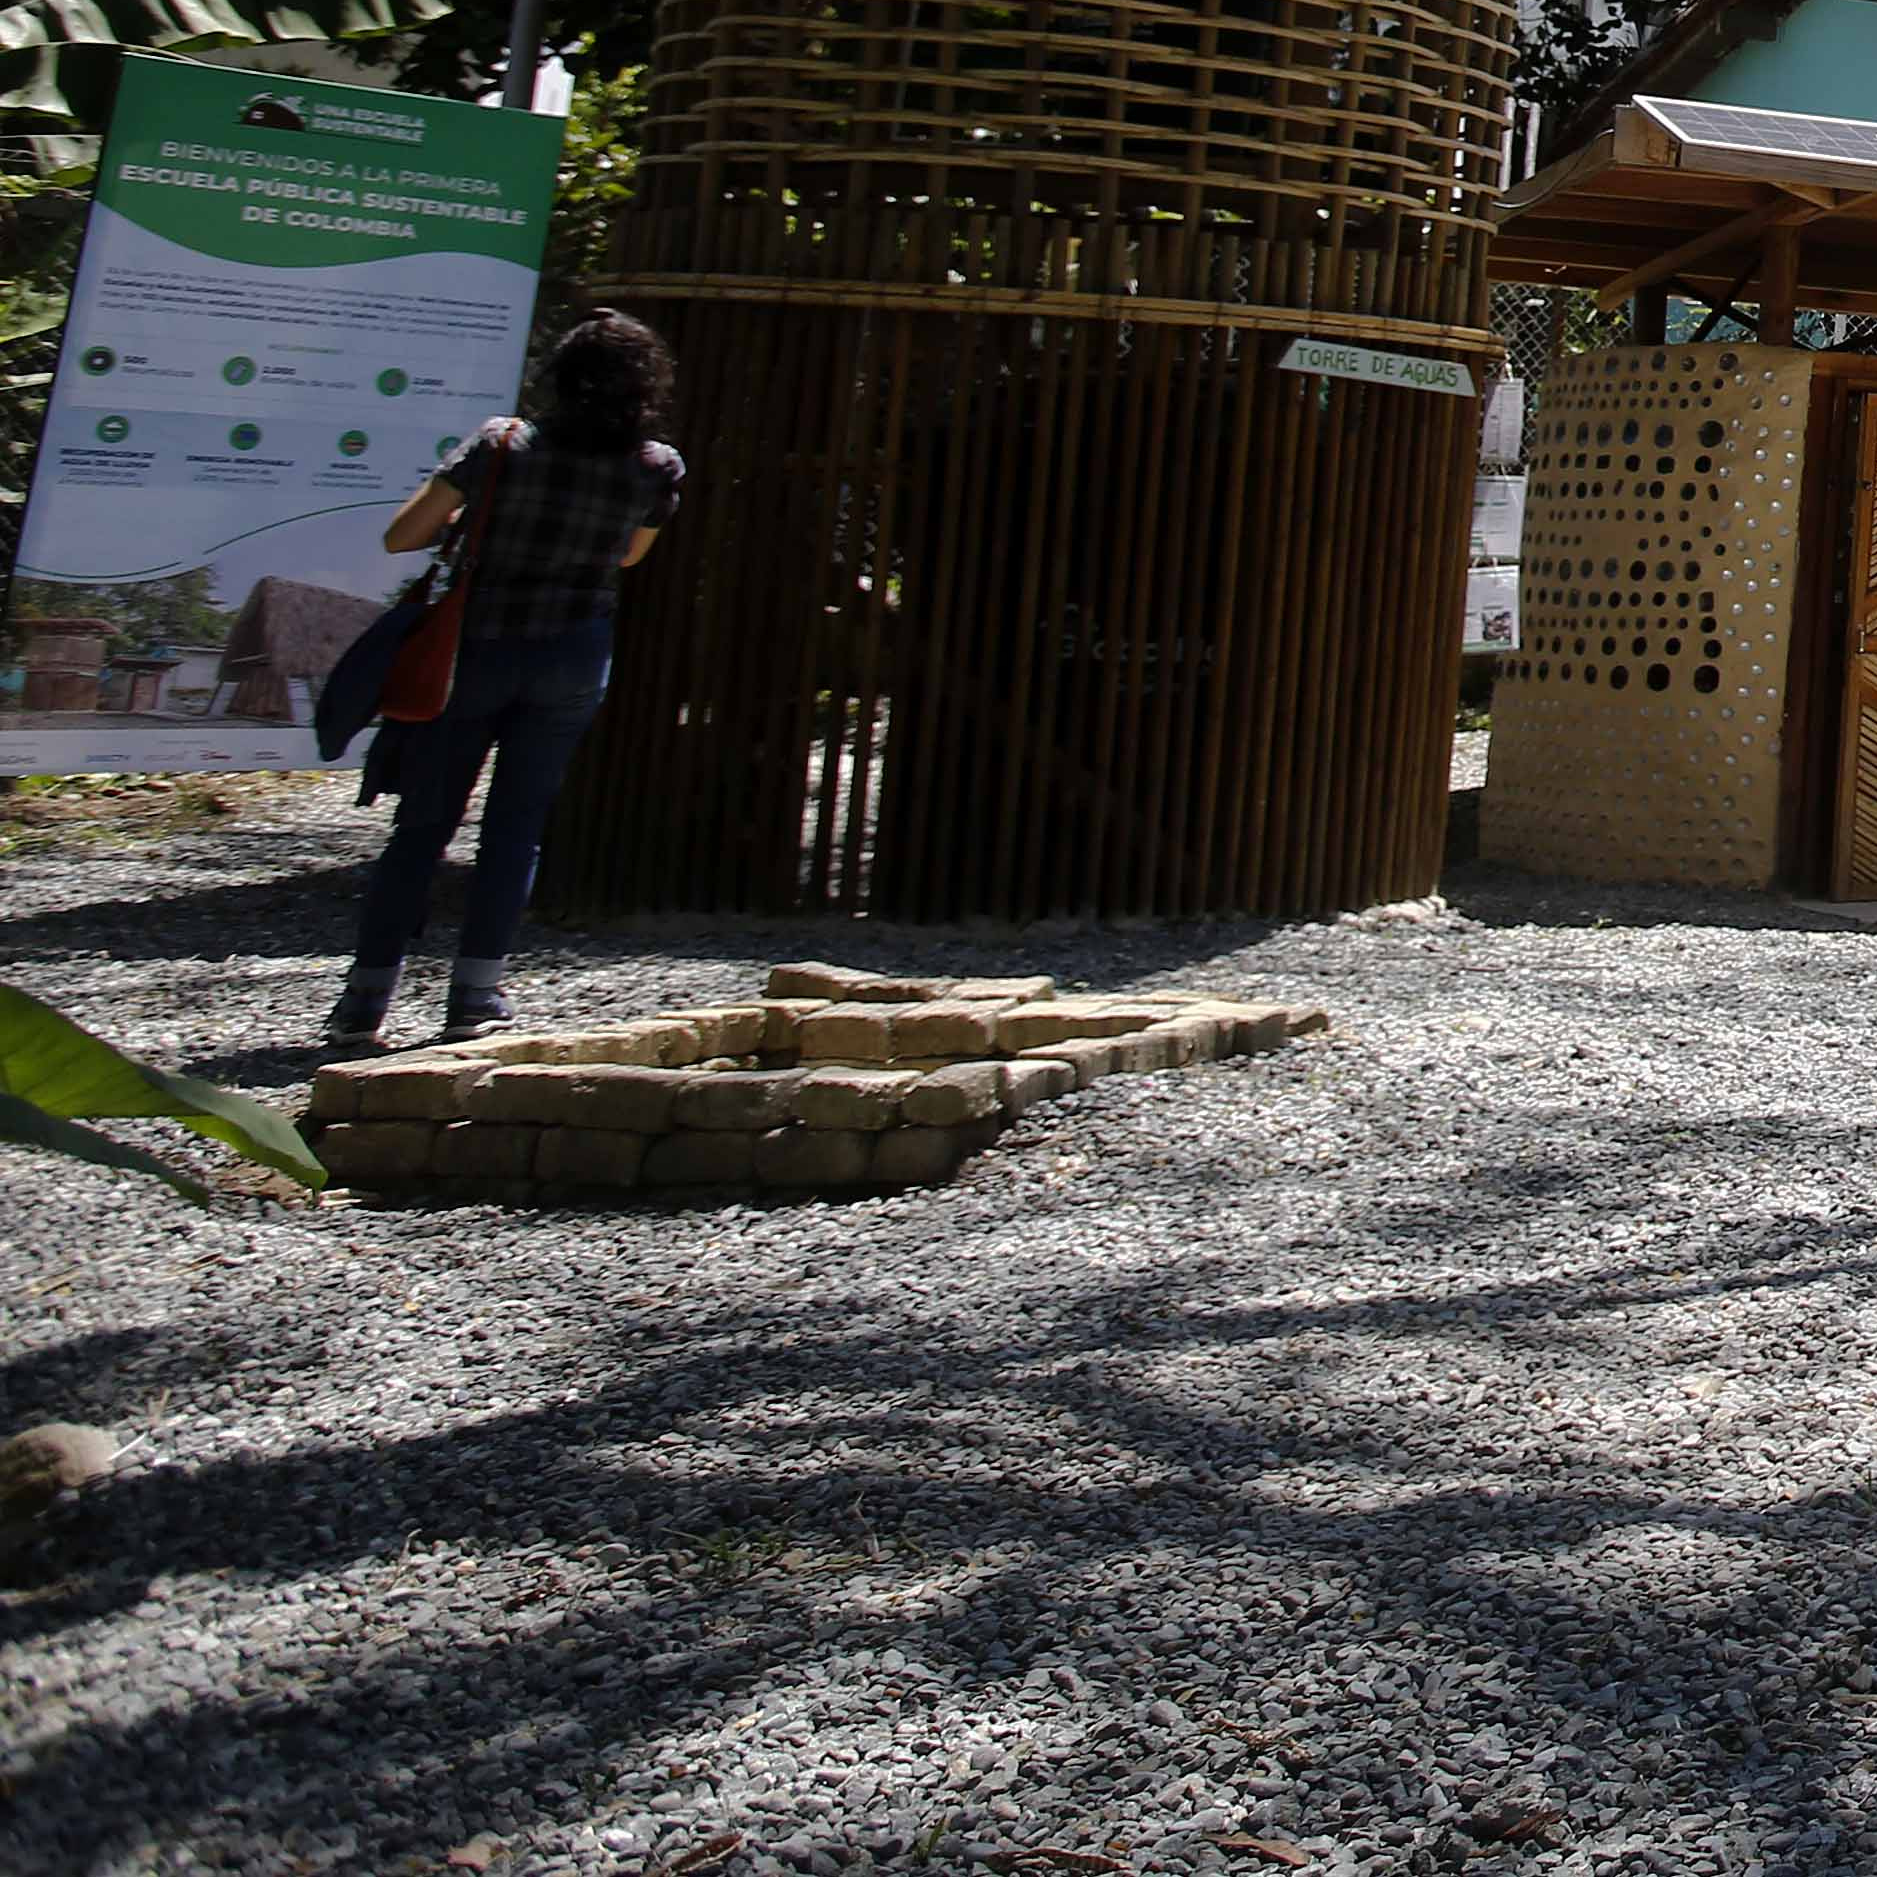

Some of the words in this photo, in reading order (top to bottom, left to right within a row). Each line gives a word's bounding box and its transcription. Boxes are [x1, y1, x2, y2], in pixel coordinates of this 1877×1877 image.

[160, 141, 335, 178] BIENVENIDOS
[337, 163, 357, 181] A
[362, 166, 393, 184] LA
[399, 171, 502, 197] PRIMERA
[119, 163, 241, 193] ESCUELA
[246, 174, 357, 206] PÚBLICA
[360, 192, 528, 225] SUSTENTABLE
[242, 206, 280, 225] DE
[284, 210, 417, 239] COLOMBIA
[1297, 347, 1360, 372] TORRE
[1372, 355, 1394, 375] DE
[1401, 362, 1459, 388] AGUAS
